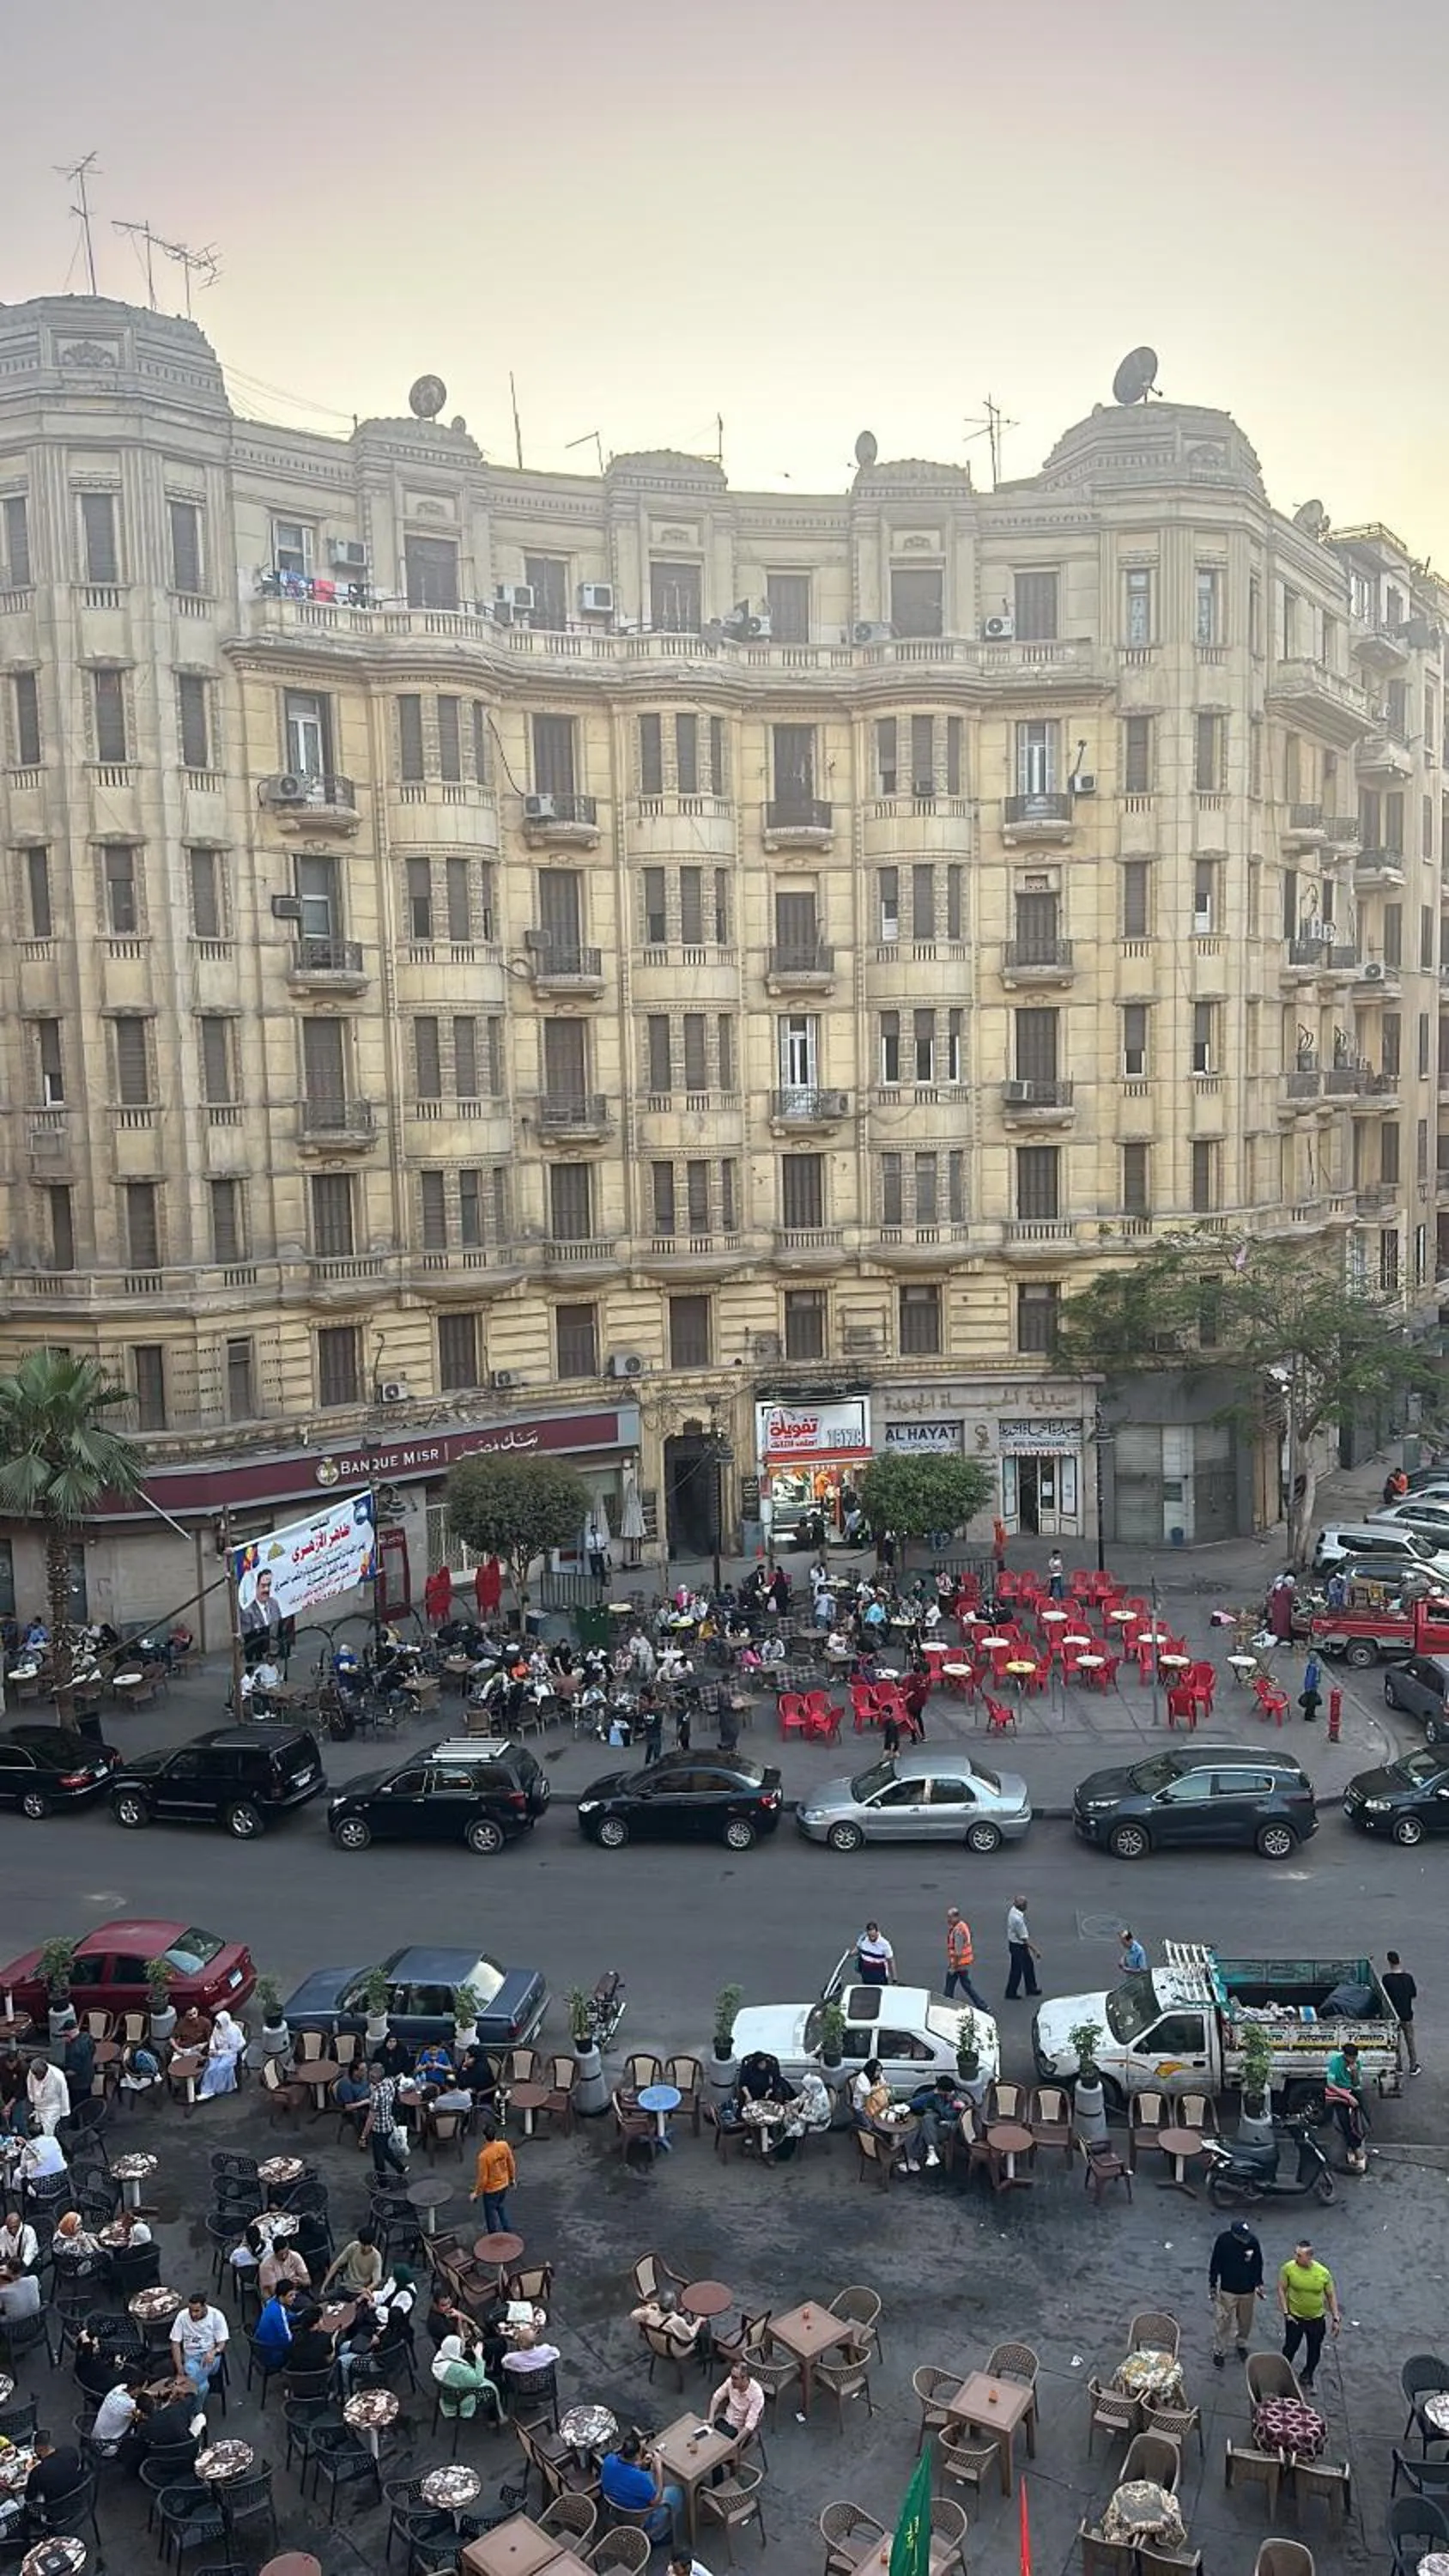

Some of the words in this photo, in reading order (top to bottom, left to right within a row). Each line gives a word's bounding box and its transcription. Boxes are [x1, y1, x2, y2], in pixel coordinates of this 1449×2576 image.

[770, 1409, 818, 1438] تفويلة
[885, 1428, 905, 1442] AL
[907, 1426, 959, 1441] HAYAT
[454, 1439, 500, 1461] مصر
[500, 1429, 538, 1450] بنك
[341, 1455, 398, 1474] BANQUE
[403, 1448, 439, 1465] MISR
